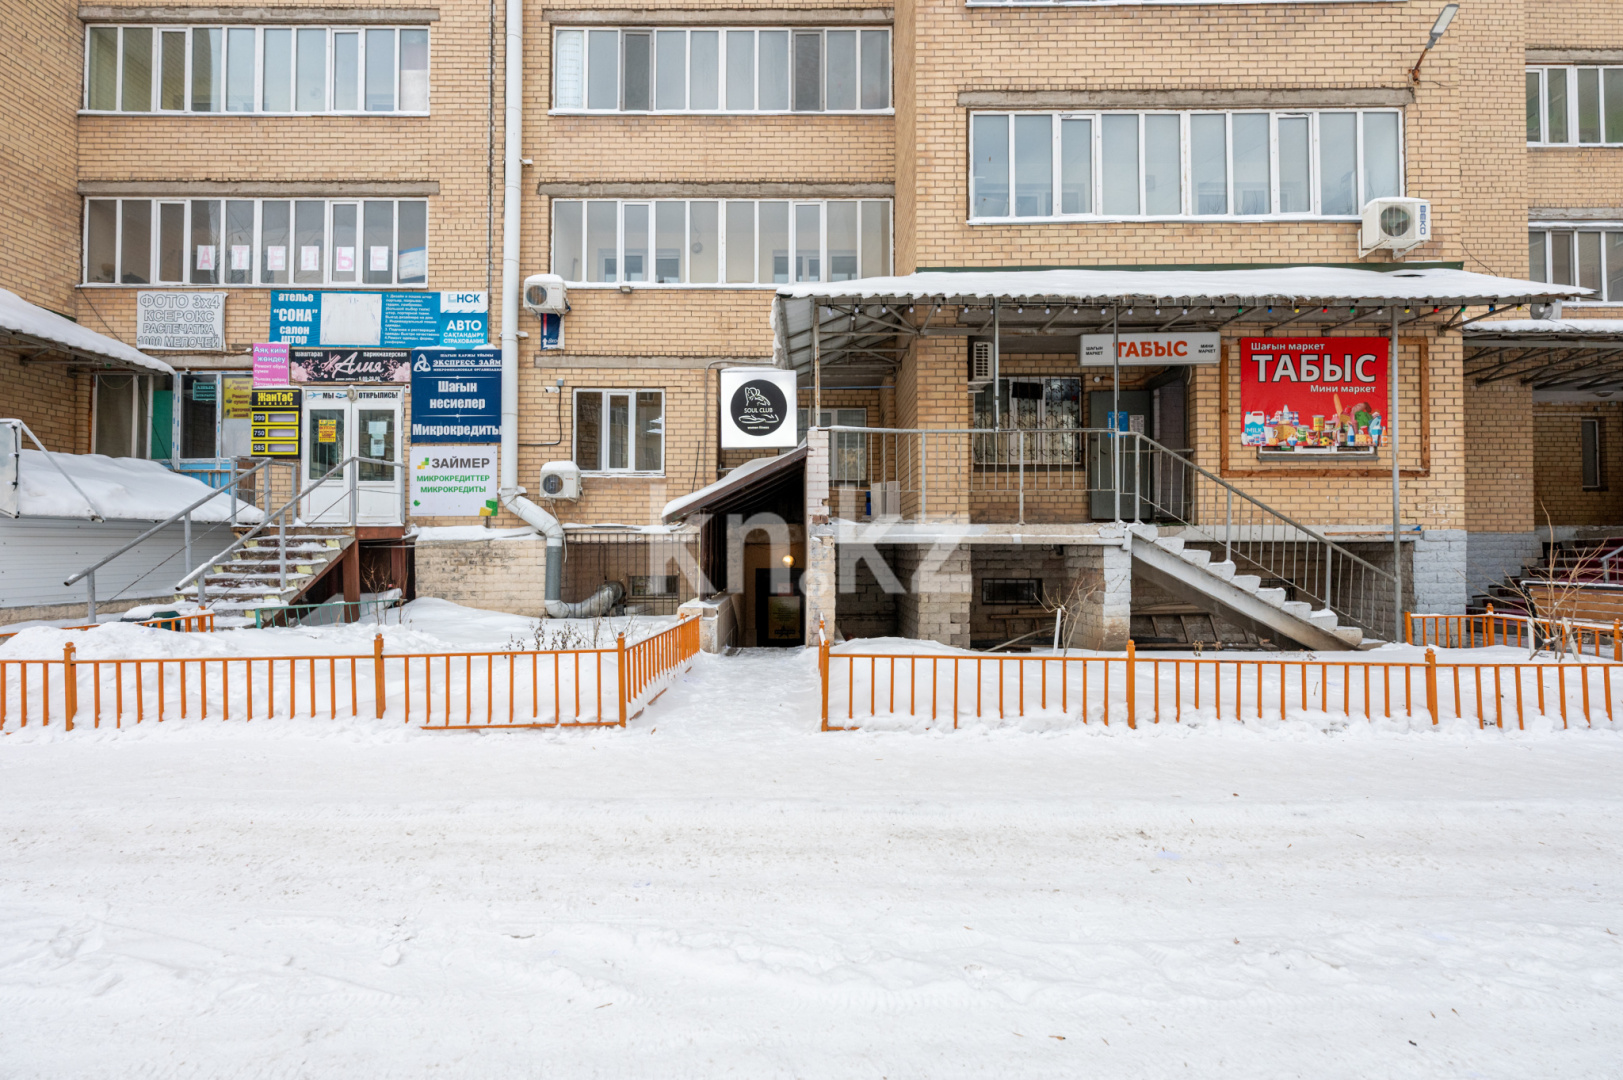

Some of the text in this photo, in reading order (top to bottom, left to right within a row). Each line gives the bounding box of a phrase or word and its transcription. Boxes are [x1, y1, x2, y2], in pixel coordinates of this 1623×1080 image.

[140, 294, 189, 309] ФОТО
[278, 293, 314, 302] ателье
[144, 309, 215, 323] КСЕРОКС
[279, 326, 310, 335] салон
[446, 319, 482, 331] АВТО
[137, 333, 220, 348] 1000 МЕЛОЧЕЙ
[281, 335, 307, 345] штор
[1112, 340, 1188, 358] ТАБЫС
[1250, 342, 1325, 352] Шағын маркет
[332, 351, 384, 378] Алия
[1251, 353, 1377, 383] ТАБЫС
[438, 381, 478, 393] Шағын
[1310, 385, 1376, 394] Мини маркет
[257, 392, 294, 402] ЖанТаС
[358, 391, 398, 399] ОТКРЫЛИСЬ!
[429, 398, 486, 410] несиелер
[412, 424, 502, 437] Микрокредиты
[431, 456, 490, 469] ЗАЙМЕР
[416, 475, 490, 483] МИКРОКРЕДИТТЕР
[420, 486, 486, 494] МИКРОКРЕДИТЫ
